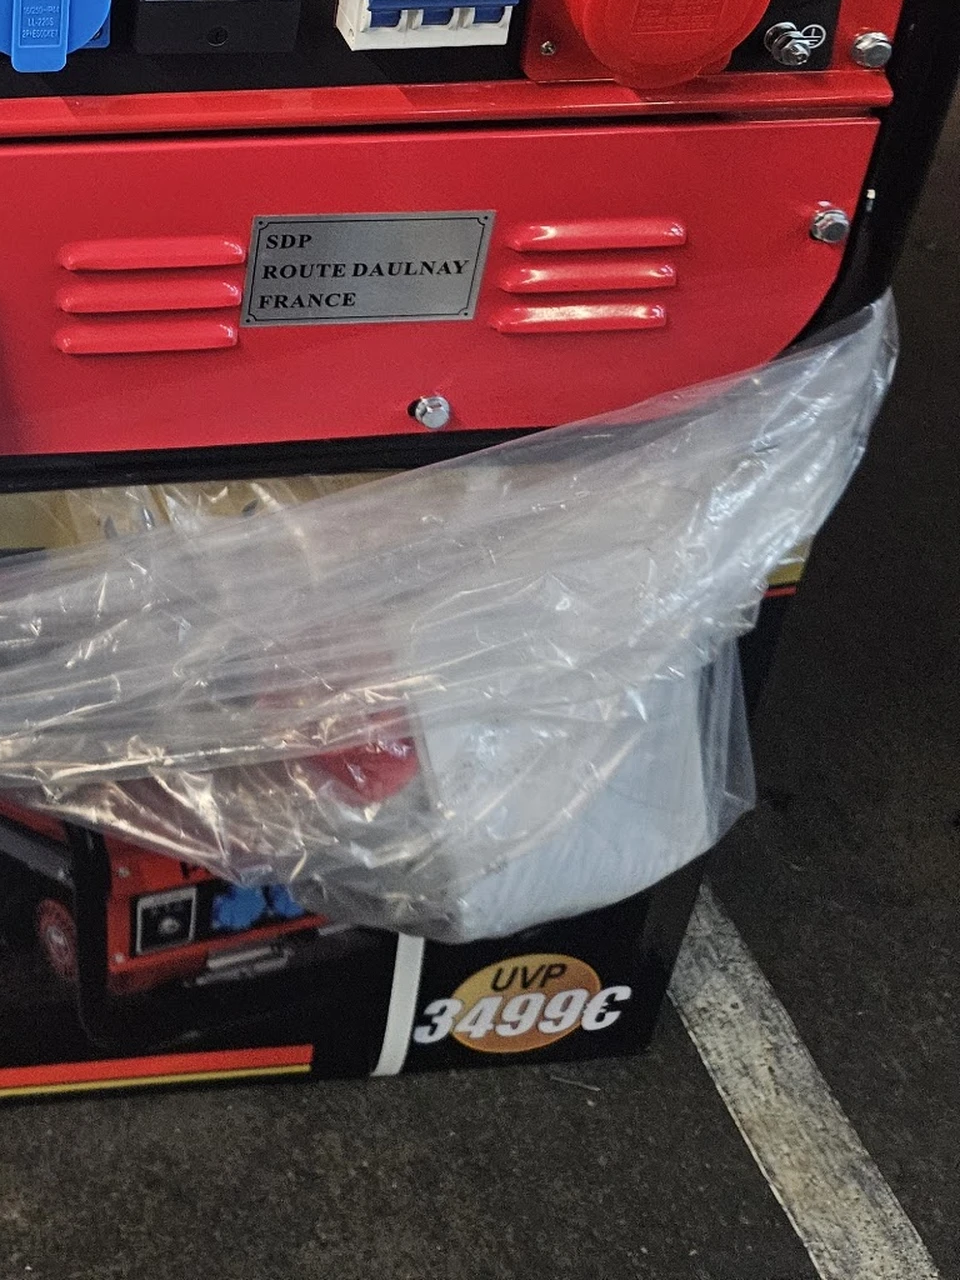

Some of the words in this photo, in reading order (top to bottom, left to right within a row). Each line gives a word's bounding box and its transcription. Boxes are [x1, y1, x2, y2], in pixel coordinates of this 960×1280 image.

[265, 233, 312, 249] SDP
[261, 262, 346, 280] ROUTE
[351, 259, 469, 278] DAULNAY
[258, 292, 356, 310] FRANCE
[491, 963, 567, 992] UVP
[413, 985, 632, 1044] 3499€
